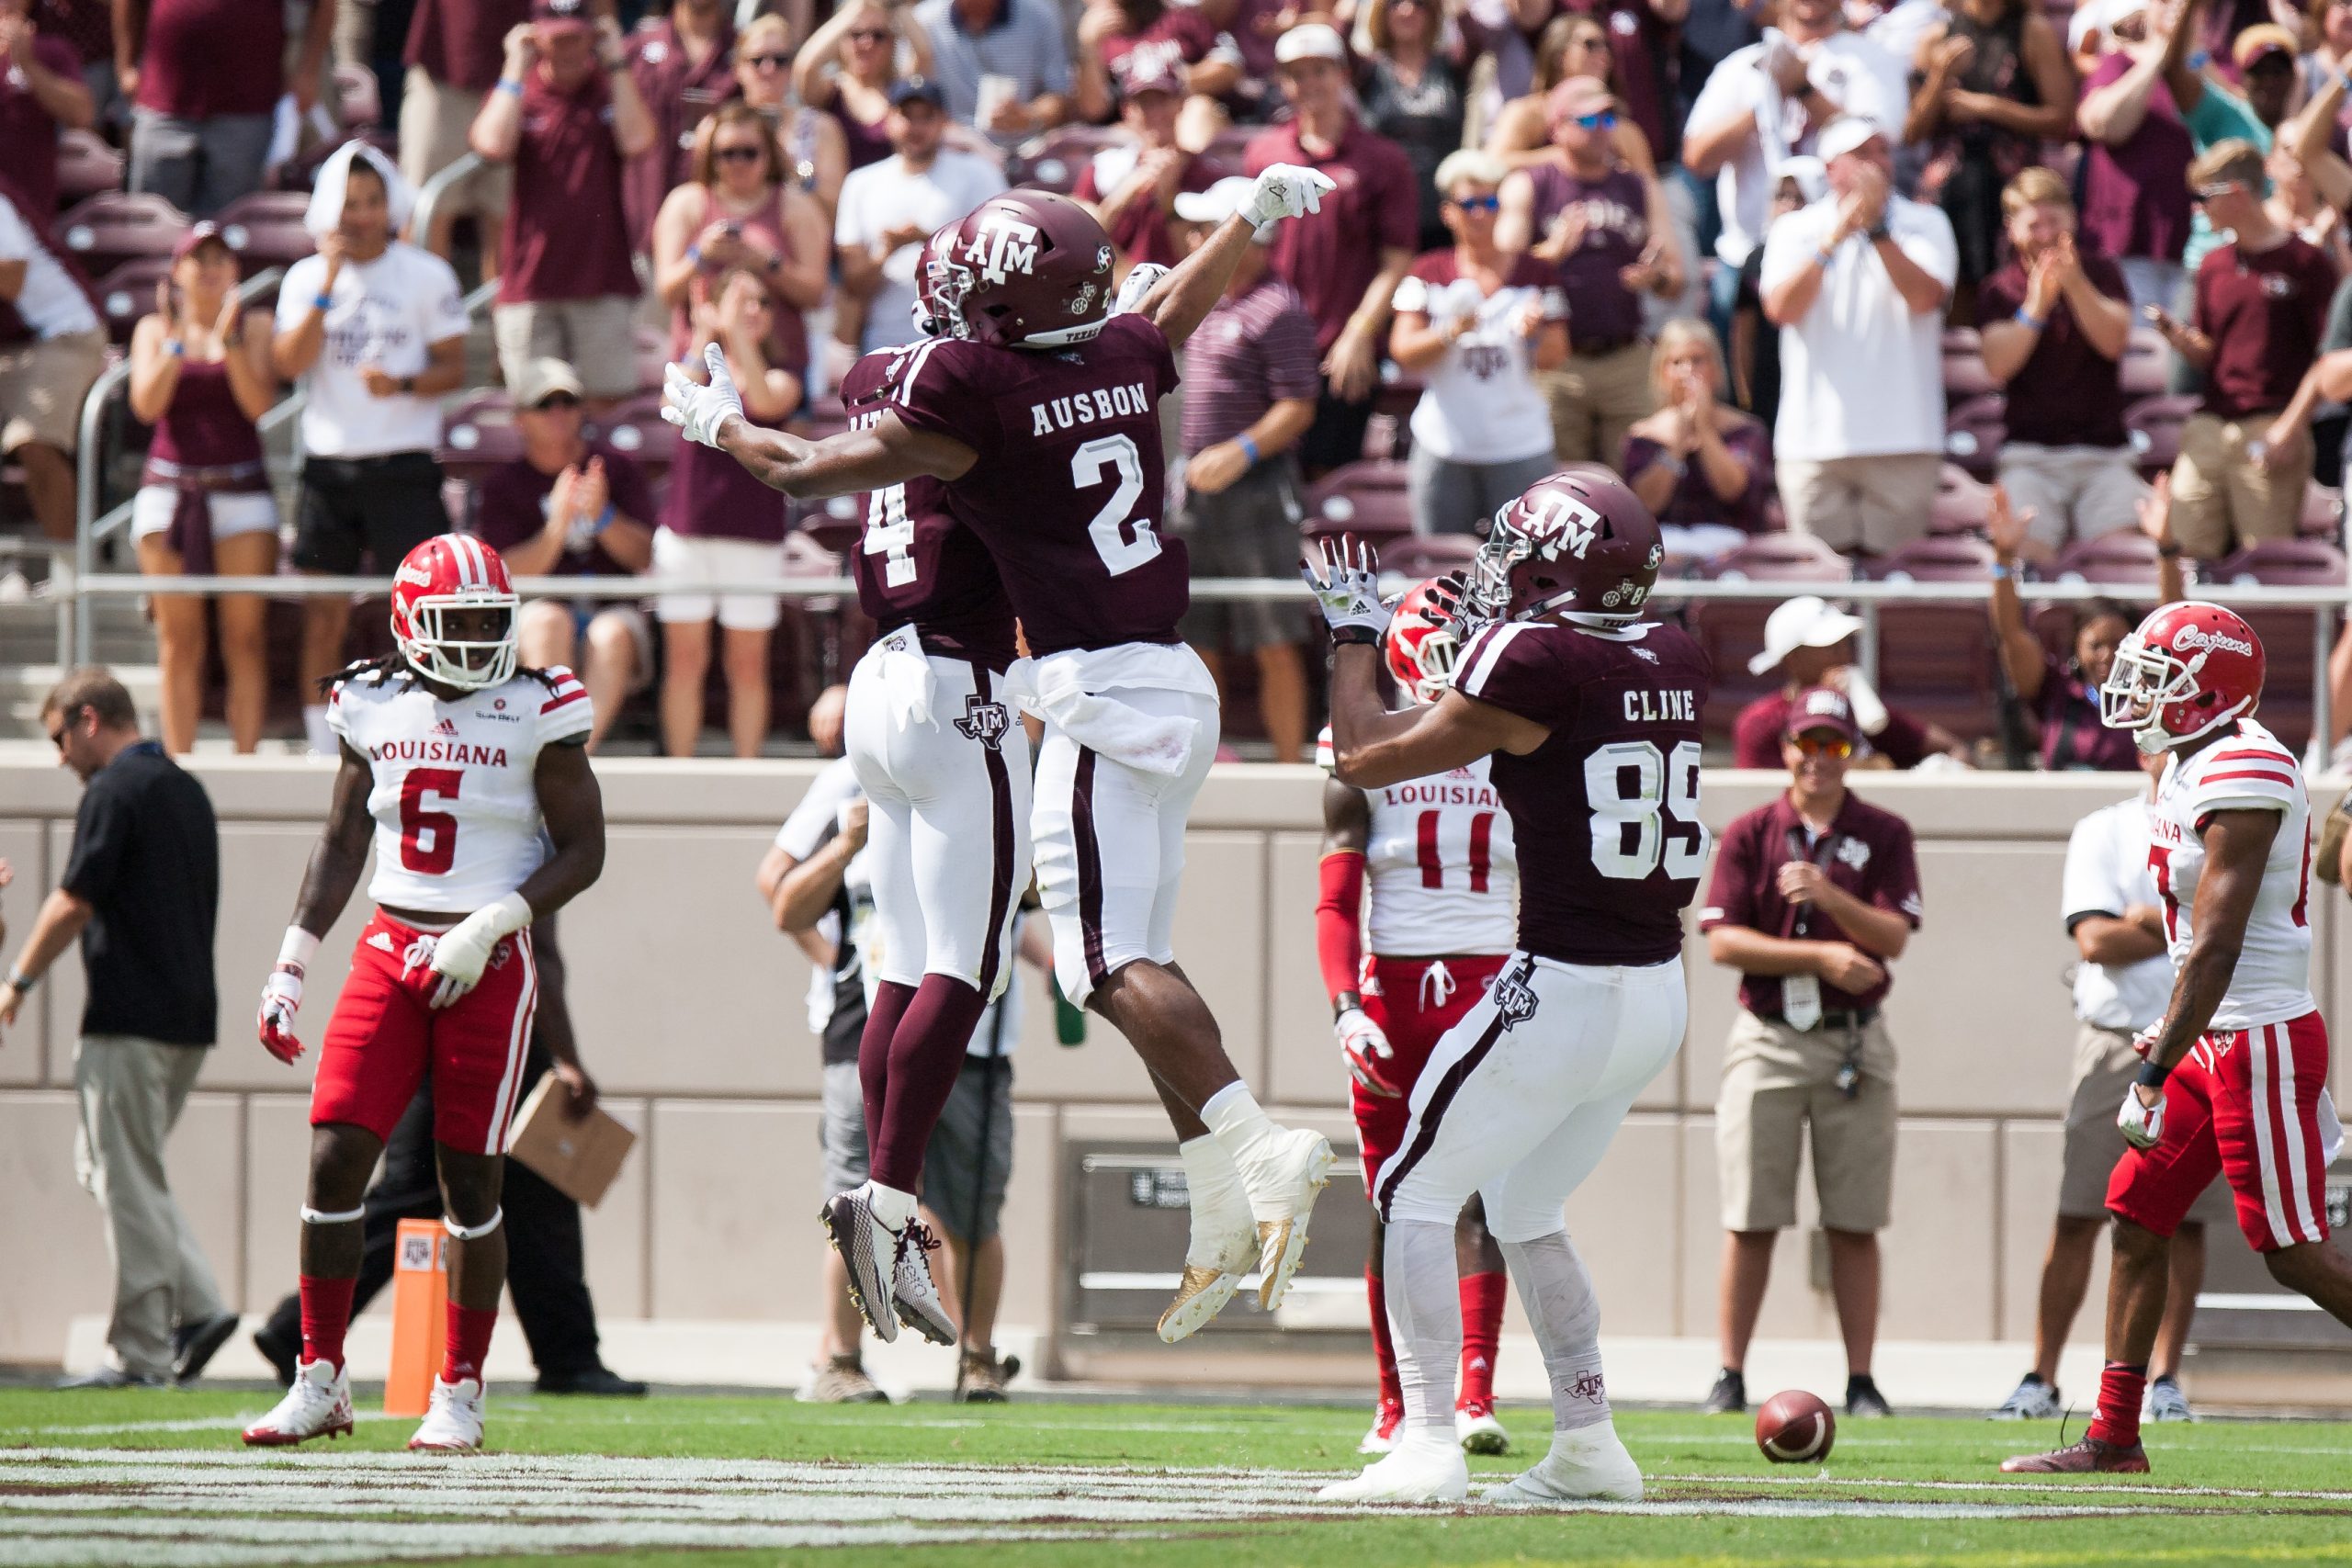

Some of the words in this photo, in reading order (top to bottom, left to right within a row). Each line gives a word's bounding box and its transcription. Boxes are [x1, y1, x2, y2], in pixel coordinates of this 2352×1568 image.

[1031, 382, 1149, 436] AUSBON
[864, 482, 917, 589] 4
[1071, 433, 1162, 577] 2
[2172, 624, 2252, 657] Cajuns
[1623, 690, 1695, 721] CLINE
[368, 740, 508, 768] LOUISIANA
[400, 766, 465, 875] 6
[1417, 808, 1495, 894] 11
[1584, 740, 1711, 880] 89
